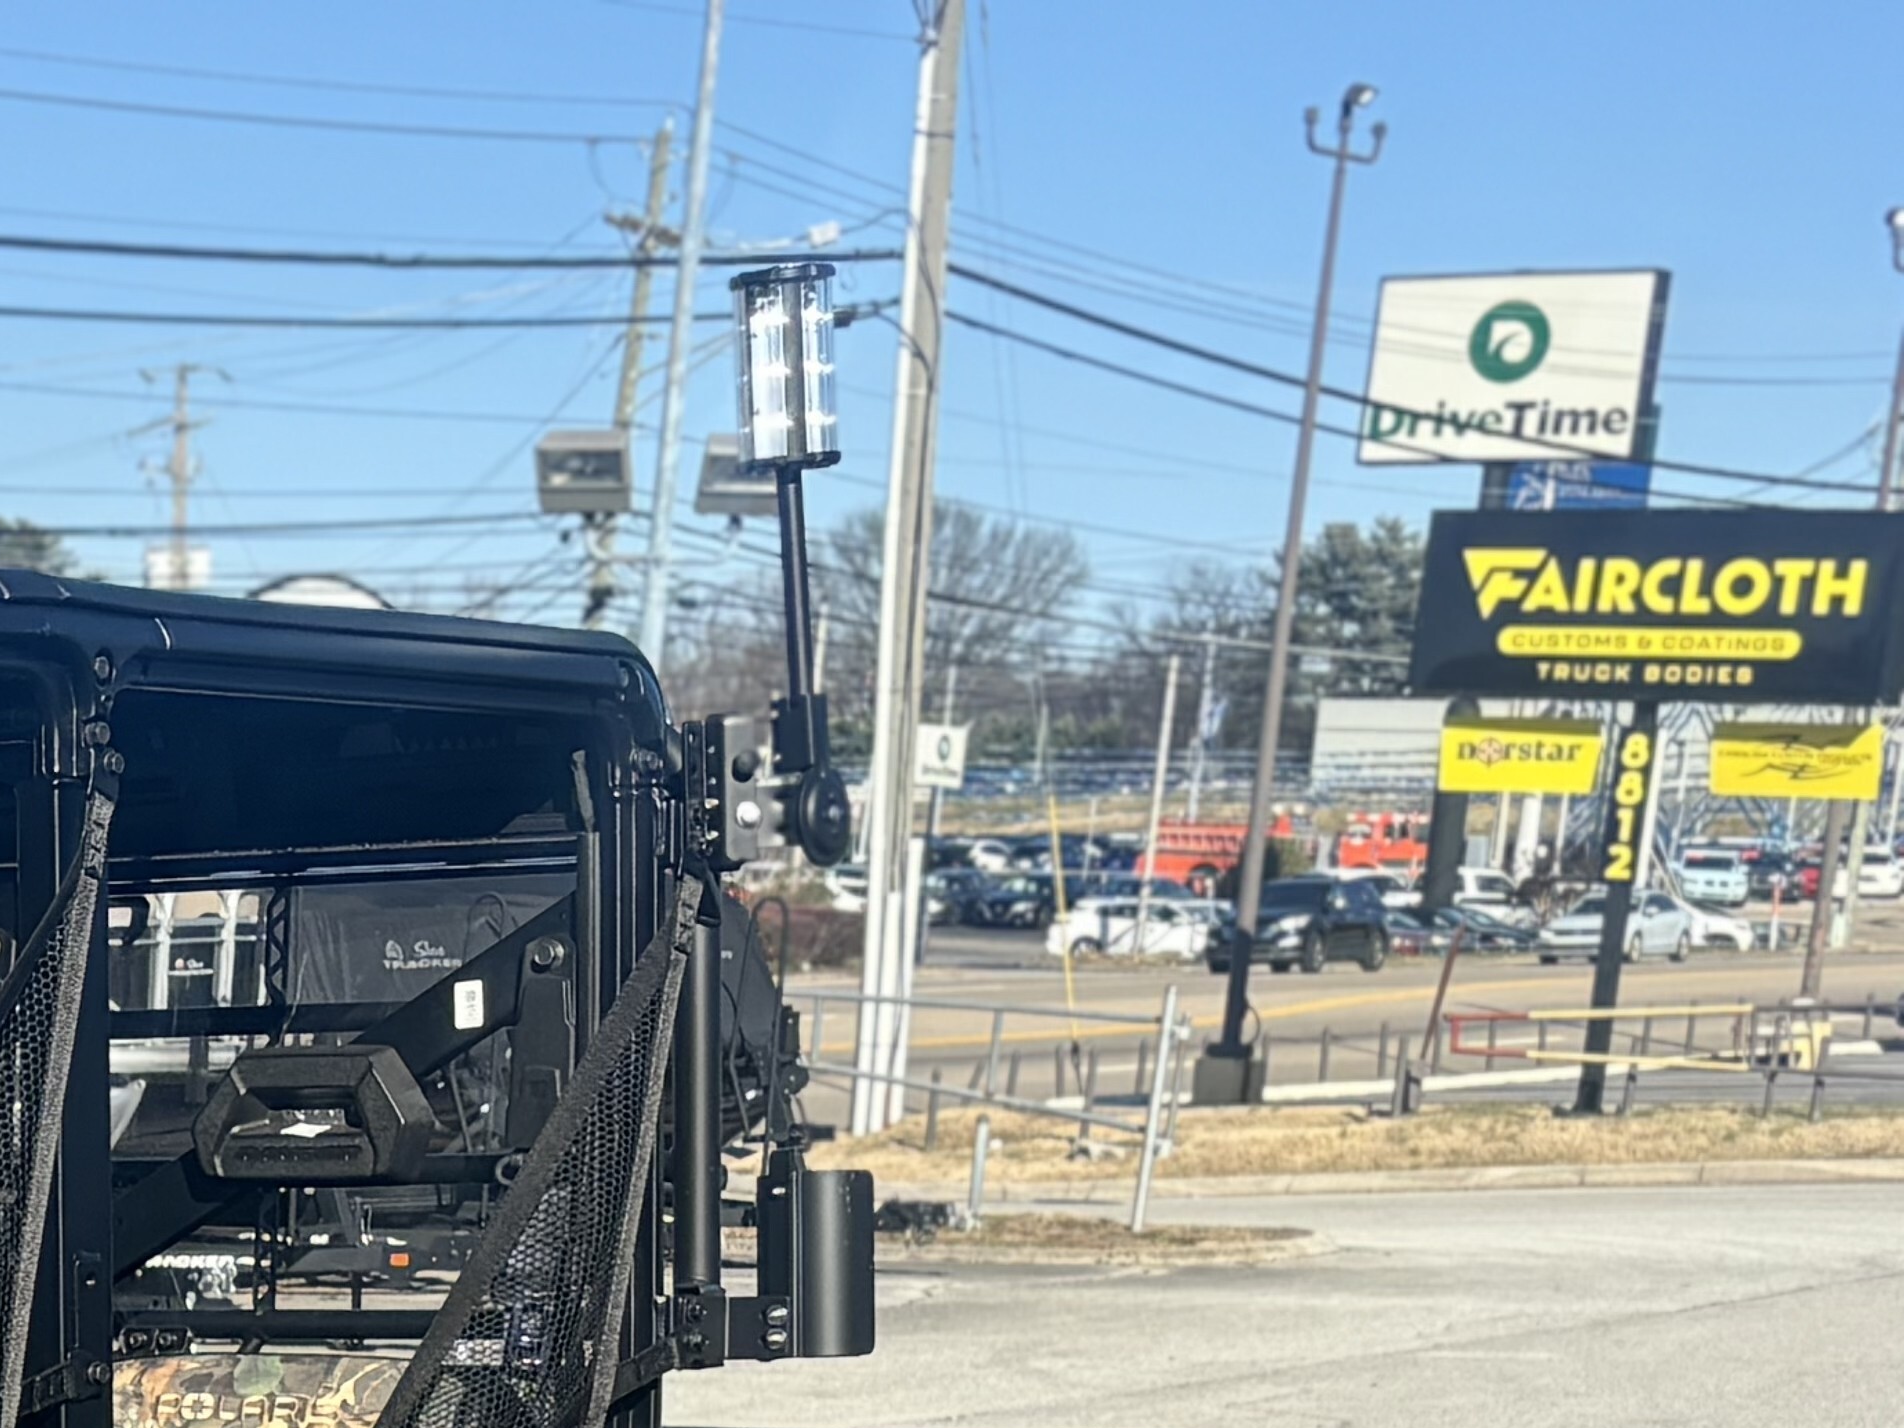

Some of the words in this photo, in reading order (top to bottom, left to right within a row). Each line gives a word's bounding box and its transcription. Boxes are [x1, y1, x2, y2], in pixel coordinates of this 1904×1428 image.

[1369, 399, 1630, 440] DriveTime
[1462, 547, 1869, 620] FAIRCLOTH
[1511, 632, 1629, 651] CUSTOMS
[1637, 637, 1653, 651] &
[1661, 635, 1789, 653] COATINGS
[1536, 662, 1632, 682] TRUCK
[1643, 663, 1754, 685] BODIES
[1603, 731, 1650, 882] 8812
[155, 1391, 341, 1426] POLARIS
